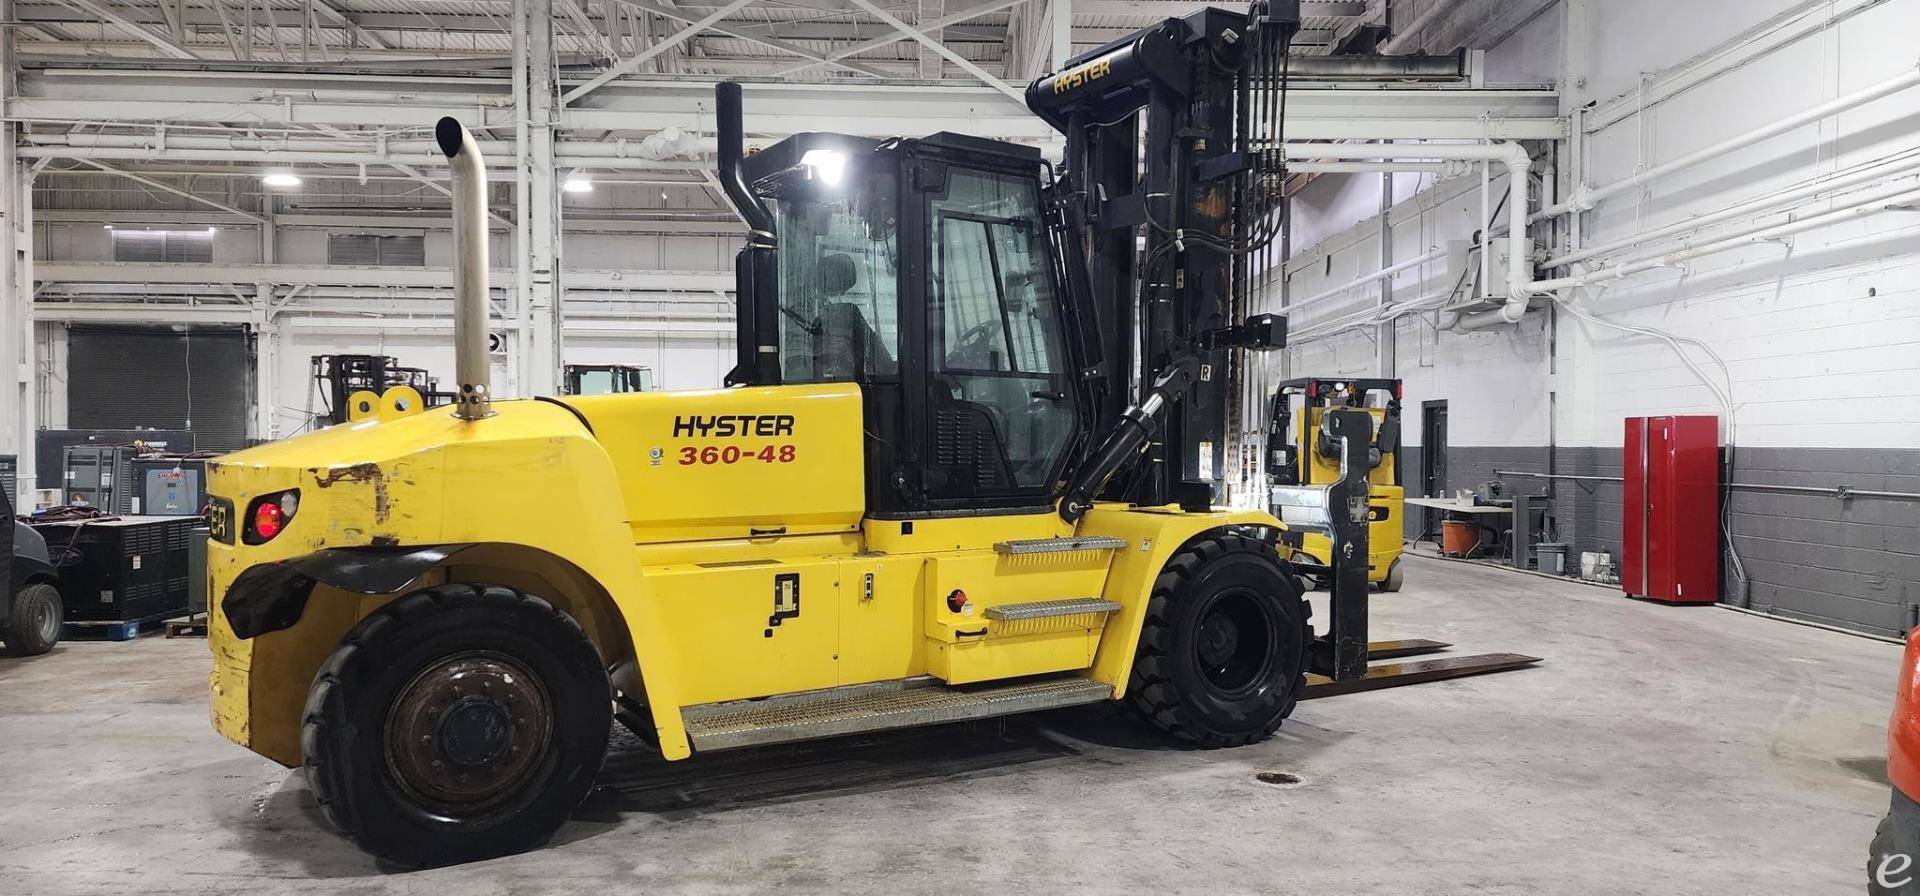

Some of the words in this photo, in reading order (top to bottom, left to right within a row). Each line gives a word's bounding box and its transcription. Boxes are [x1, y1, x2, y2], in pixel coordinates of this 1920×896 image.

[1054, 57, 1111, 95] HYSTER
[1201, 366, 1209, 380] R
[672, 415, 795, 438] HYSTER
[678, 444, 796, 466] 360-48
[211, 505, 226, 537] ER
